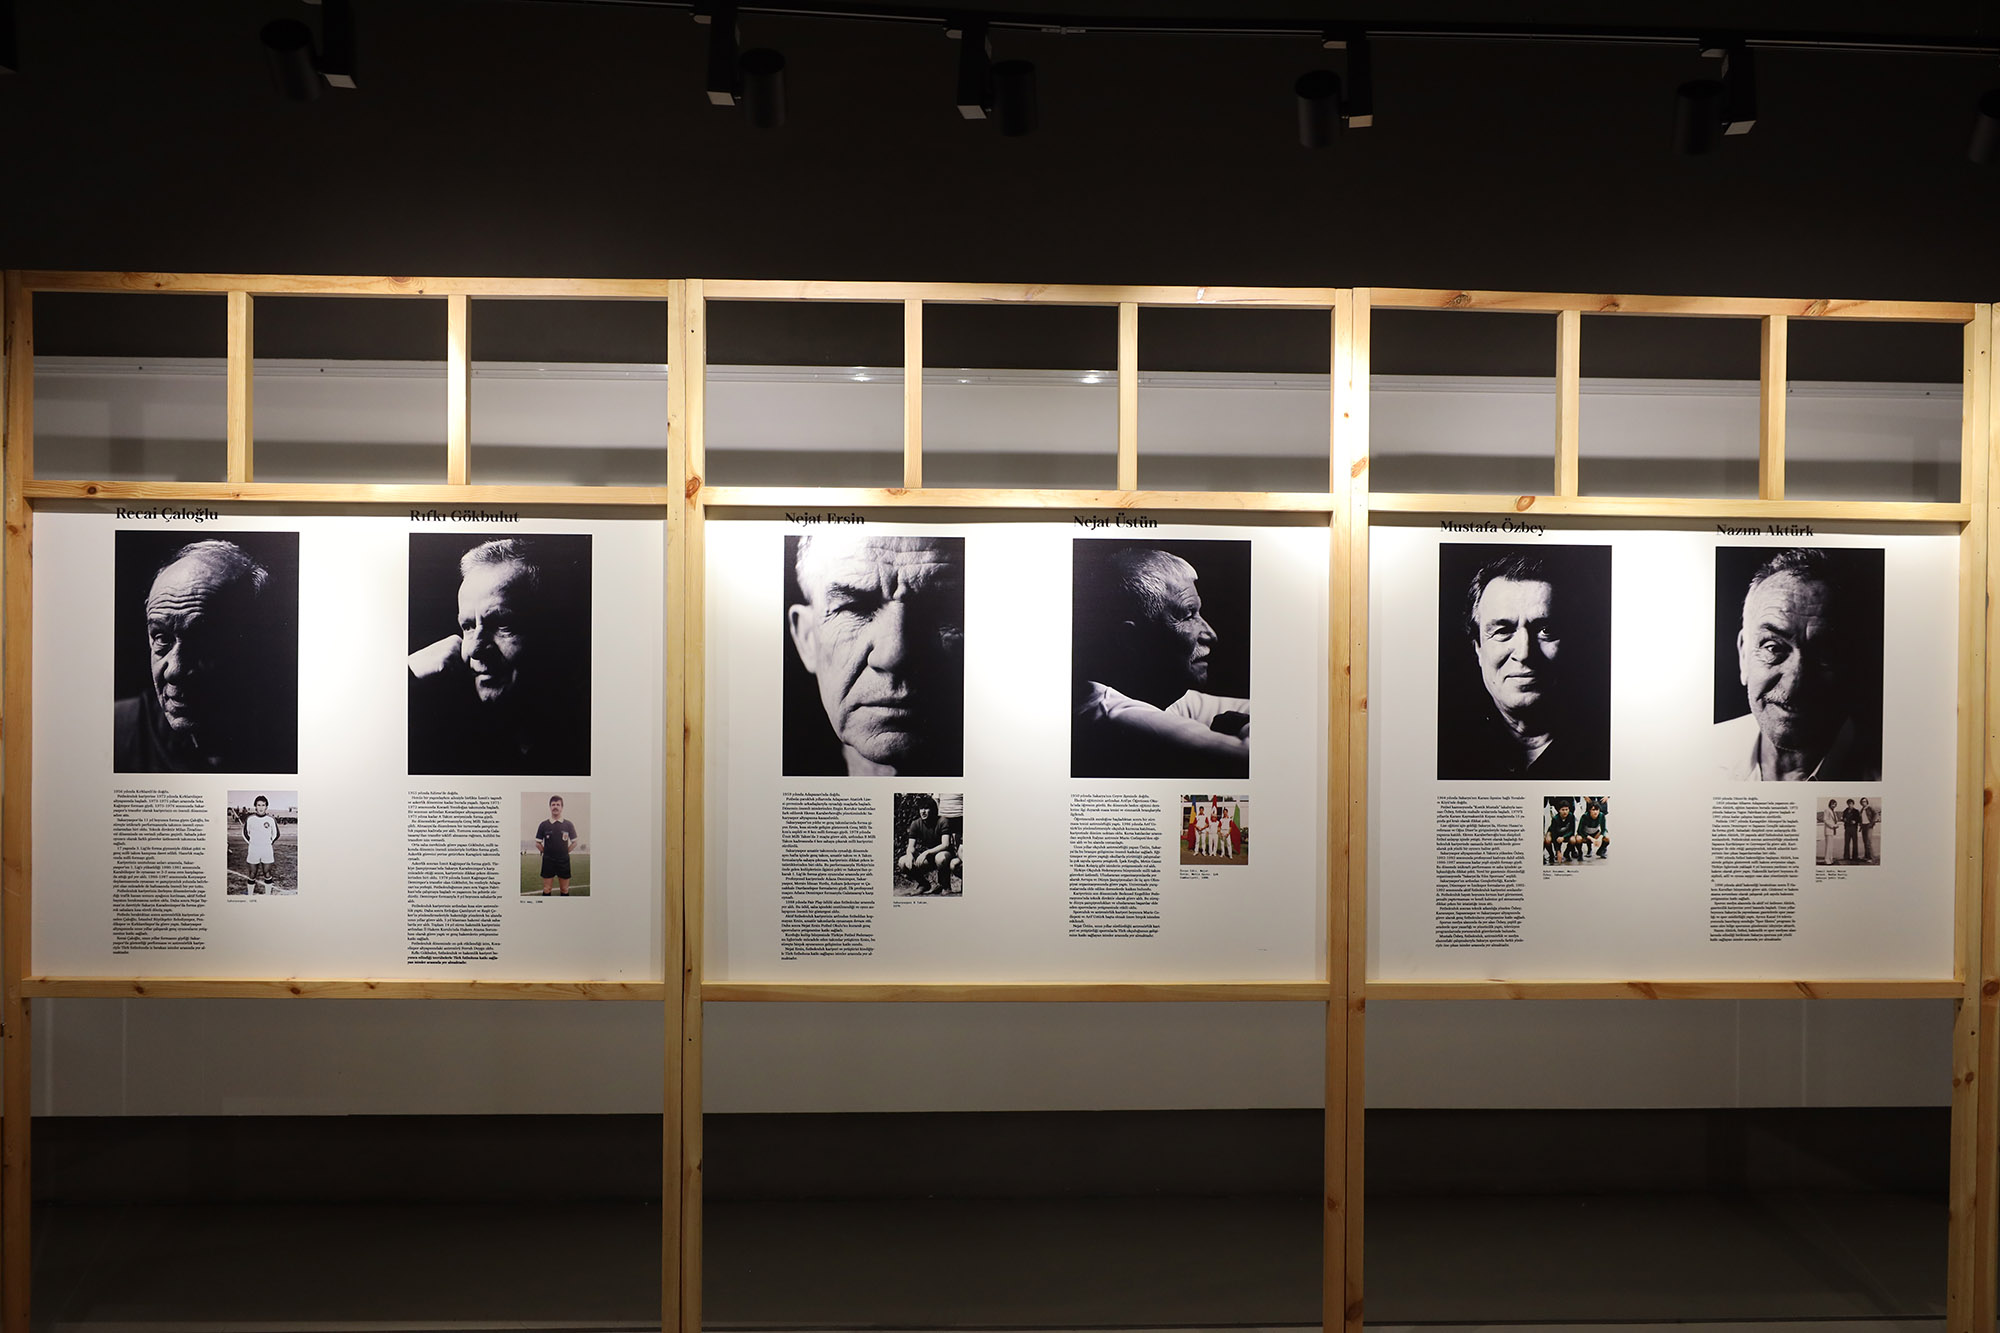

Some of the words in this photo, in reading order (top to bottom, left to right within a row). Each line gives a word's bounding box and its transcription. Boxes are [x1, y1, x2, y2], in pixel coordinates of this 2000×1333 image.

[116, 507, 157, 520] Recai
[161, 507, 219, 523] Çaloğlu
[410, 510, 446, 522] Rıfkı
[451, 510, 520, 523] Gökbulut
[786, 512, 823, 527] Nejat
[828, 512, 865, 525] Ersin
[1074, 515, 1111, 530] Nejat
[1116, 512, 1158, 528] Üstün
[1441, 520, 1497, 533] Mustafa
[1502, 517, 1545, 536] Özbey
[1717, 524, 1761, 536] Nazım
[1766, 524, 1814, 536] Aktürk
